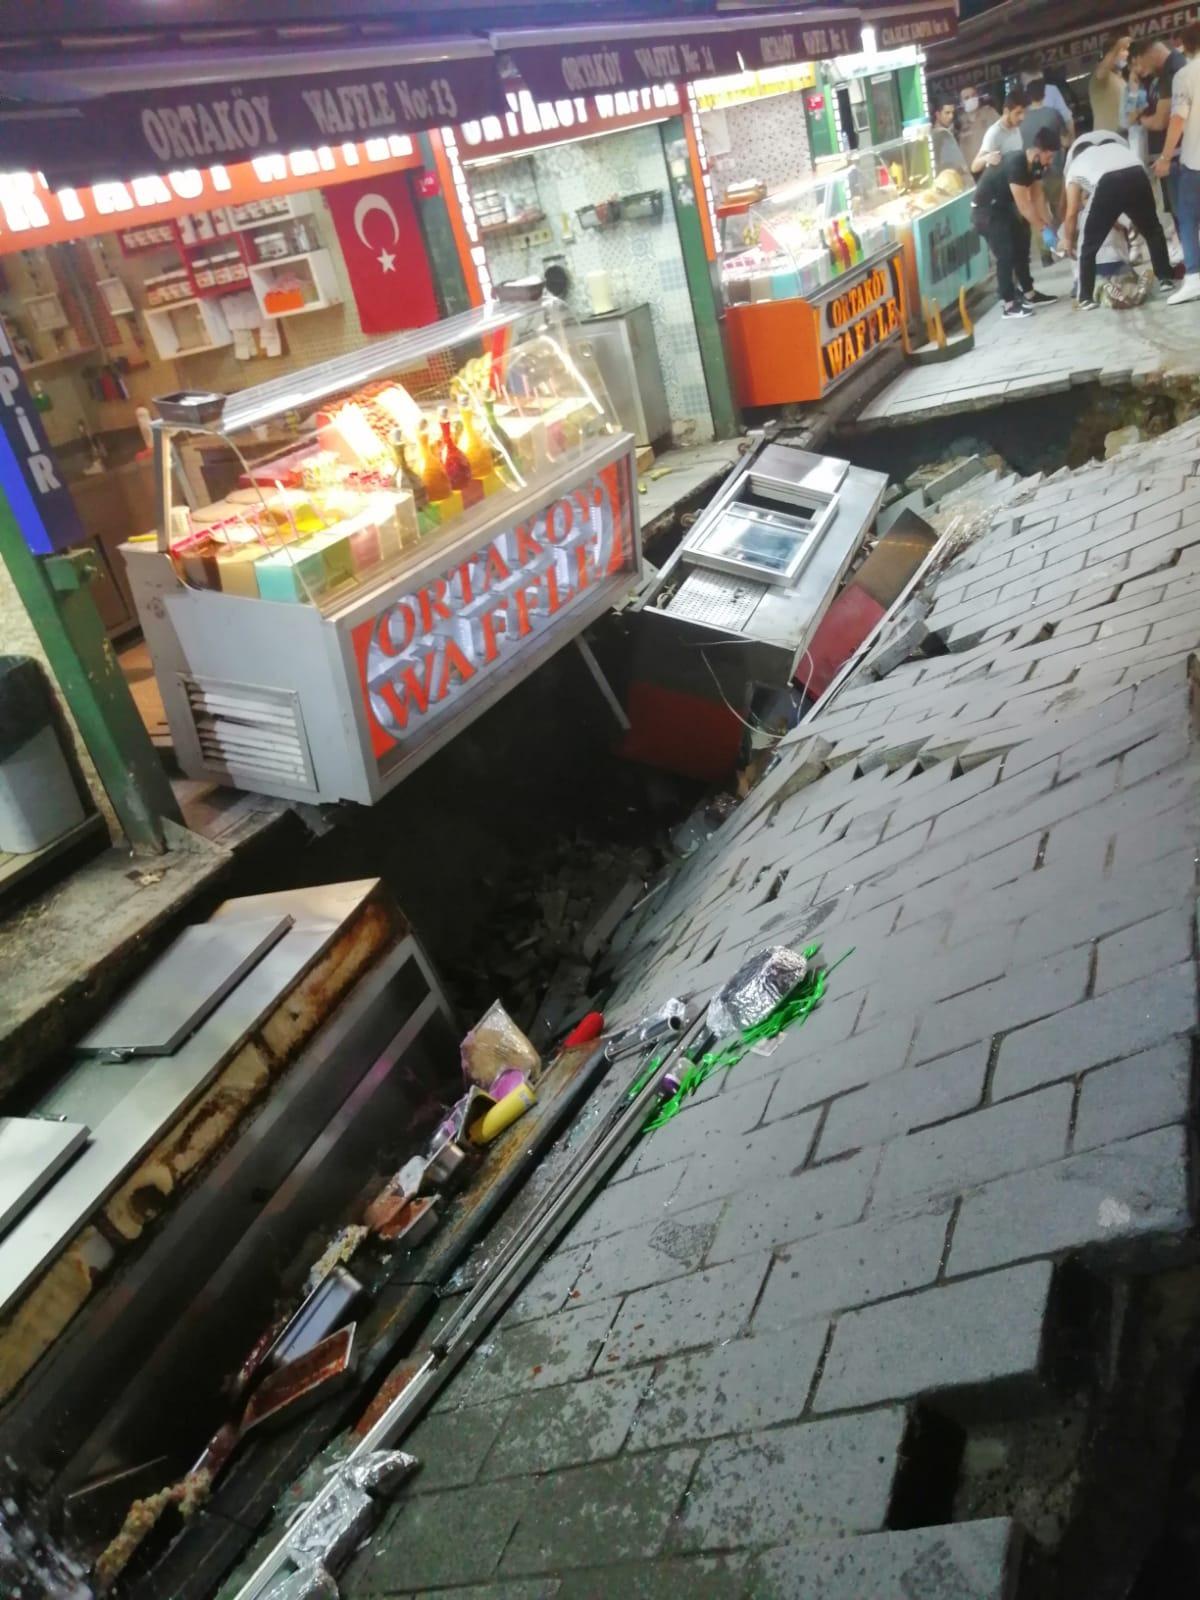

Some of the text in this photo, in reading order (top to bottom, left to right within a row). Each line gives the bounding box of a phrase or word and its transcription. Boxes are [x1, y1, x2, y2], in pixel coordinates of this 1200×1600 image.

[142, 87, 278, 162] ORTAKÖY
[303, 80, 395, 136] WAFFLE
[827, 298, 898, 378] WAFFLE
[378, 537, 602, 730] WAFFLE
